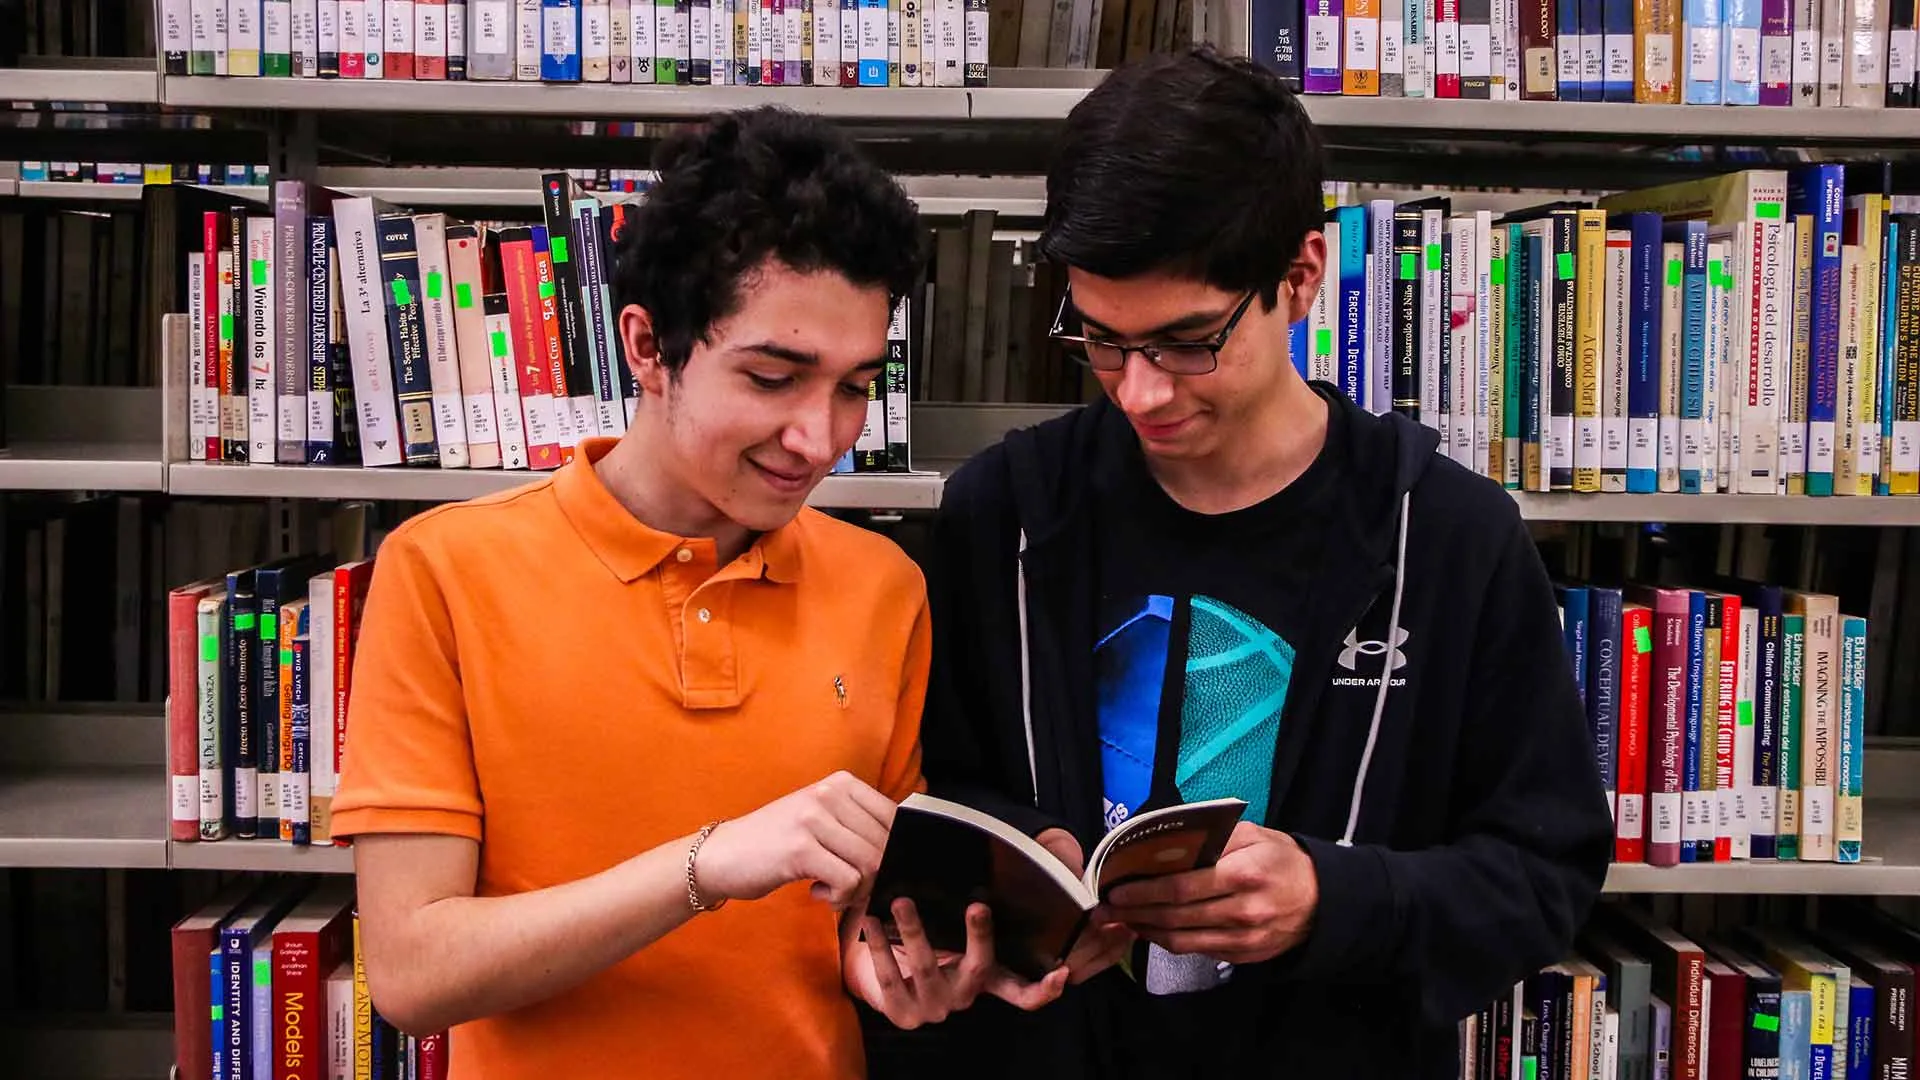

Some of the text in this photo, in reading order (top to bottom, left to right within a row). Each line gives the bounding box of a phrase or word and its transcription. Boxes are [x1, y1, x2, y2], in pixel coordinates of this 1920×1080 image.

[1825, 179, 1833, 223] SPENCINER
[312, 222, 326, 312] PRINCIPLE-CENTERED
[354, 231, 371, 314] La alternativa
[1442, 253, 1450, 270] Early
[1697, 233, 1705, 268] Pellegrini
[1753, 223, 1761, 286] INFANCIA
[285, 225, 295, 334] PRINCIPLE-CENTERED
[1910, 266, 1920, 311] CULTURE
[1318, 316, 1325, 324] La
[1347, 290, 1360, 345] PERCEPTUAL
[1384, 302, 1389, 310] IN
[1402, 284, 1413, 375] El Desarrollo del Niño
[1615, 301, 1623, 344] adolescente
[1762, 223, 1781, 406] Psicología del desarrollo
[1898, 265, 1911, 381] OF CHILDREN'S ACTION
[1911, 314, 1919, 335] AND
[251, 287, 270, 374] Viviendo los 7
[313, 313, 326, 363] LEADERSHIP
[400, 313, 413, 383] The Seven Habits
[410, 324, 421, 358] Effective
[1557, 303, 1566, 367] COMO PREVENIR
[1565, 281, 1574, 388] CONDUCTAS DESTRUCTIVAS
[1583, 334, 1596, 344] A
[1687, 280, 1703, 393] APPLIED CHILD
[1910, 340, 1918, 362] THE
[549, 336, 564, 396] Camilo Cruz
[1582, 348, 1596, 378] Good
[1749, 307, 1759, 405] ADOLESCENCIA
[1582, 382, 1596, 406] Start
[1575, 641, 1583, 653] and
[1764, 642, 1775, 677] Children
[1782, 633, 1792, 682] Aprendizaje
[1842, 636, 1853, 685] Aprendizaje
[1853, 636, 1864, 690] B.Inhelder
[1332, 678, 1407, 686] UNDER AROUR
[1596, 638, 1613, 730] CONCEPTUAL
[1688, 614, 1704, 743] Children's Unspoken Language
[1718, 660, 1736, 706] ENTERING
[1816, 651, 1829, 725] IMAGINING THE
[203, 674, 215, 757] DE LA GRANDEZA
[1662, 667, 1681, 778] The Developmental Psychology of
[1718, 708, 1734, 726] THE
[1762, 679, 1773, 746] Communicating
[1782, 688, 1791, 736] estructuras
[1843, 693, 1851, 739] estructuras
[1717, 728, 1733, 763] CHILD'S
[1762, 751, 1771, 766] The
[1781, 737, 1790, 749] del
[1842, 741, 1851, 754] del
[231, 961, 241, 1045] IDENTITY AND
[357, 992, 369, 1025] AND
[1686, 959, 1702, 1077] Individual Differences in
[1898, 988, 1906, 1031] SCHNEIDER
[285, 992, 304, 1067] Models
[1539, 1022, 1550, 1053] Change
[1592, 1000, 1604, 1075] Grief in School
[1497, 1036, 1511, 1078] Father
[1541, 1055, 1549, 1069] and
